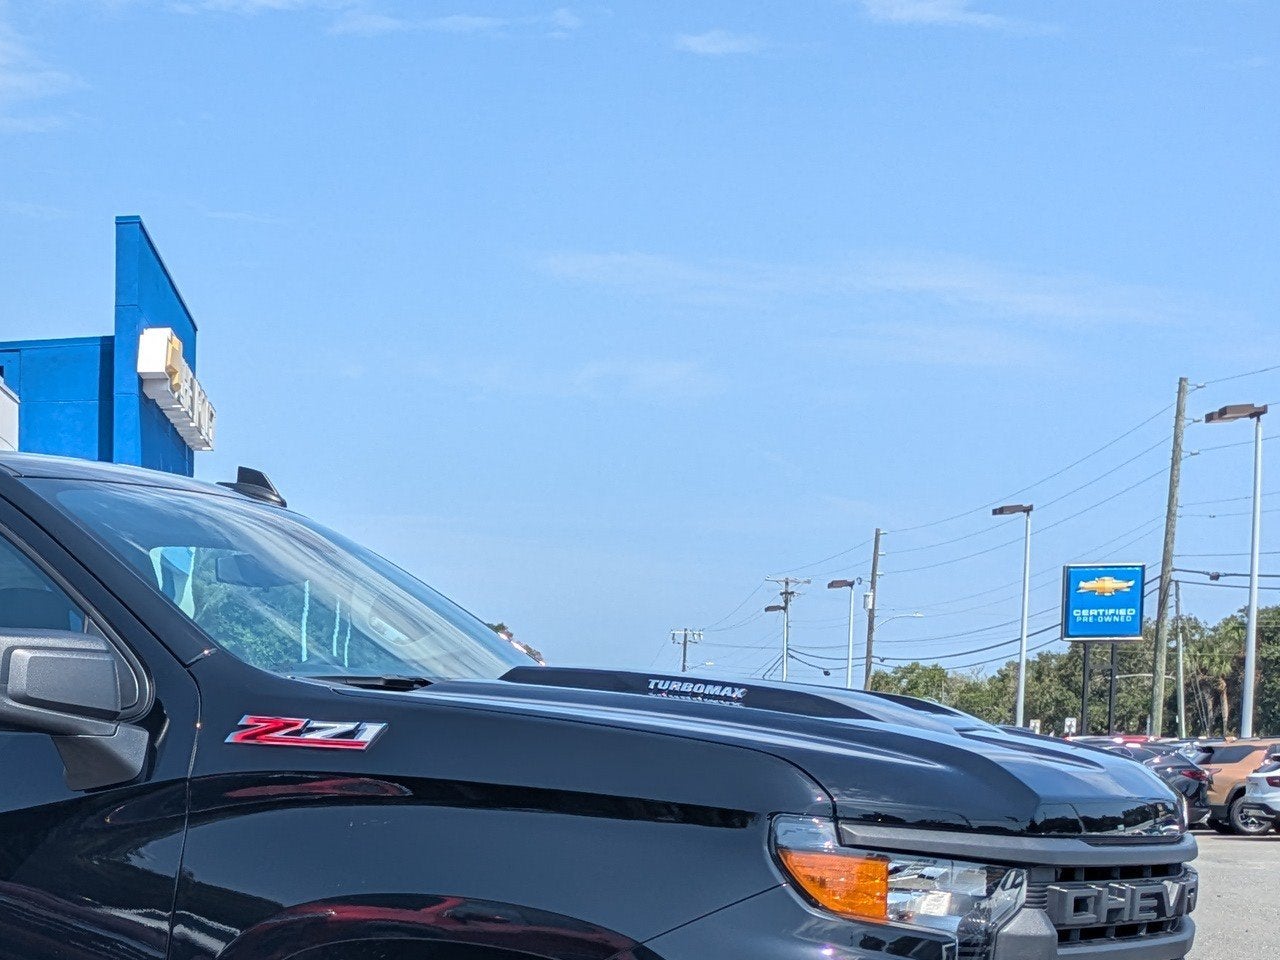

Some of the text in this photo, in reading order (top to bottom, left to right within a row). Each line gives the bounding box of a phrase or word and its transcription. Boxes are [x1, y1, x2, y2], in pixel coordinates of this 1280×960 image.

[1073, 608, 1136, 617] CERTIFIED
[648, 679, 748, 698] TURBOMAX
[224, 714, 389, 750] Z71
